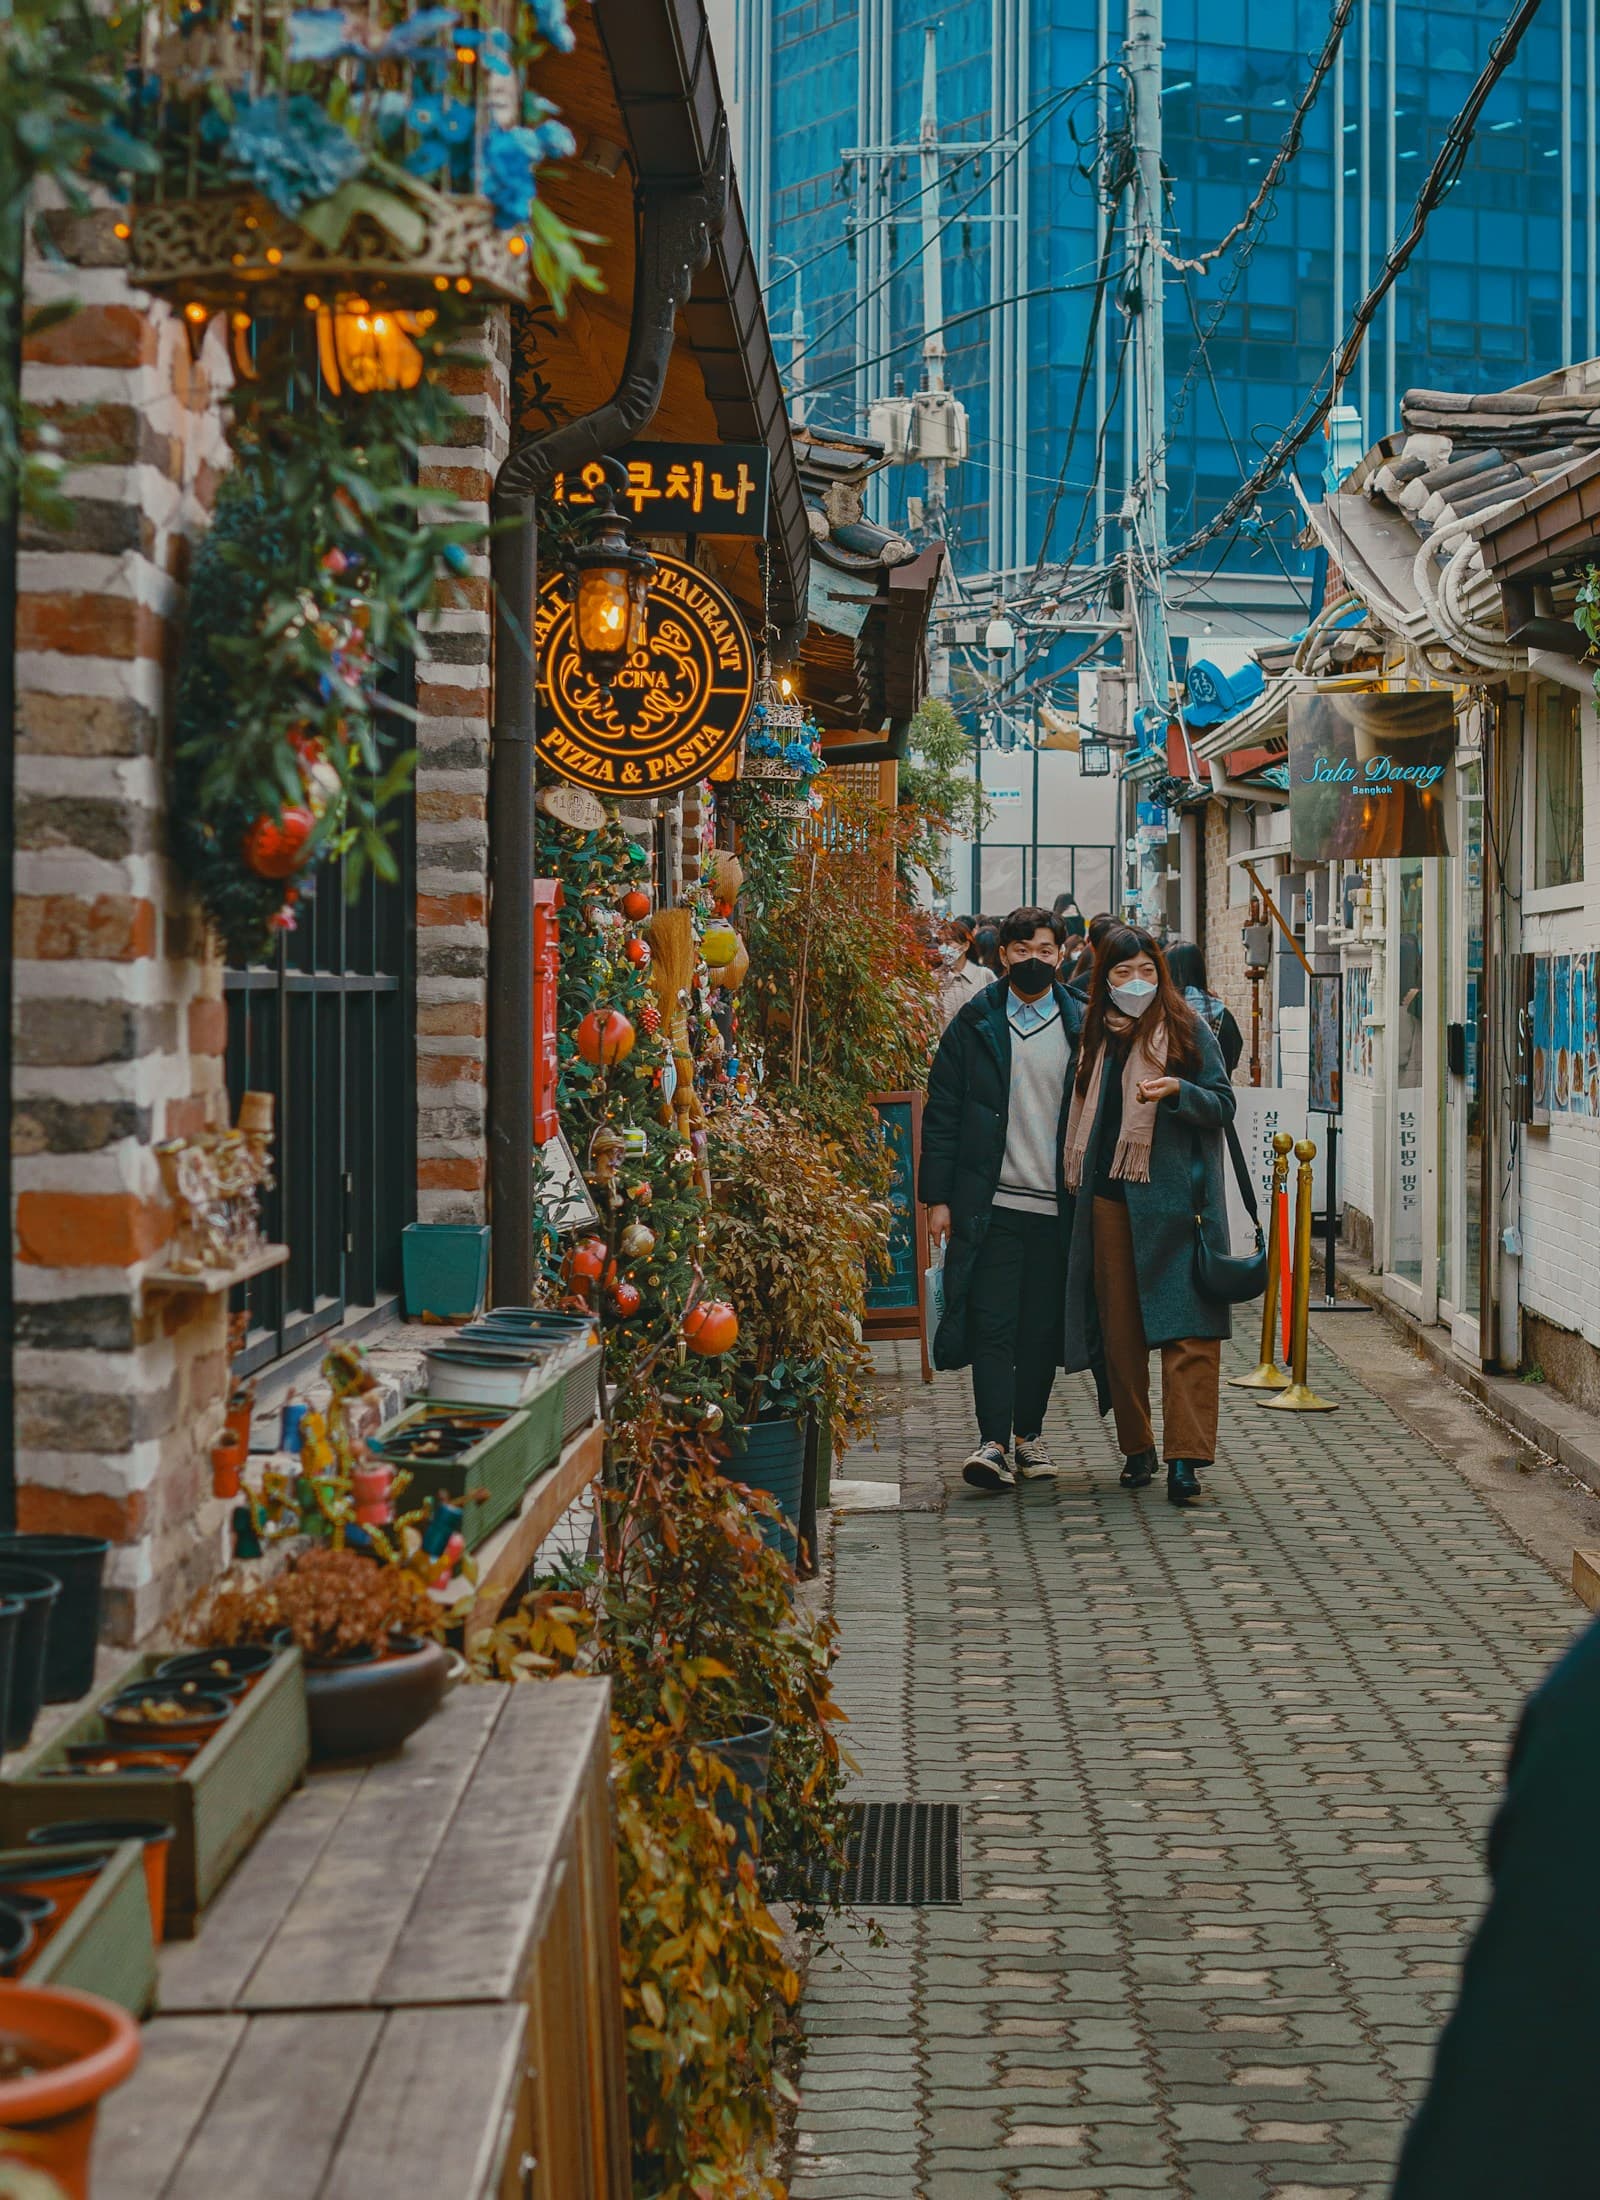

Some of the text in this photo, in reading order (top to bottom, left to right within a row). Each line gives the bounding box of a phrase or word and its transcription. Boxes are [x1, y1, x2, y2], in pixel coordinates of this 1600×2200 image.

[541, 724, 725, 784] PIZZA & PASTA
[1300, 754, 1446, 789] Sala Daeng
[1352, 785, 1393, 796] Bangkok
